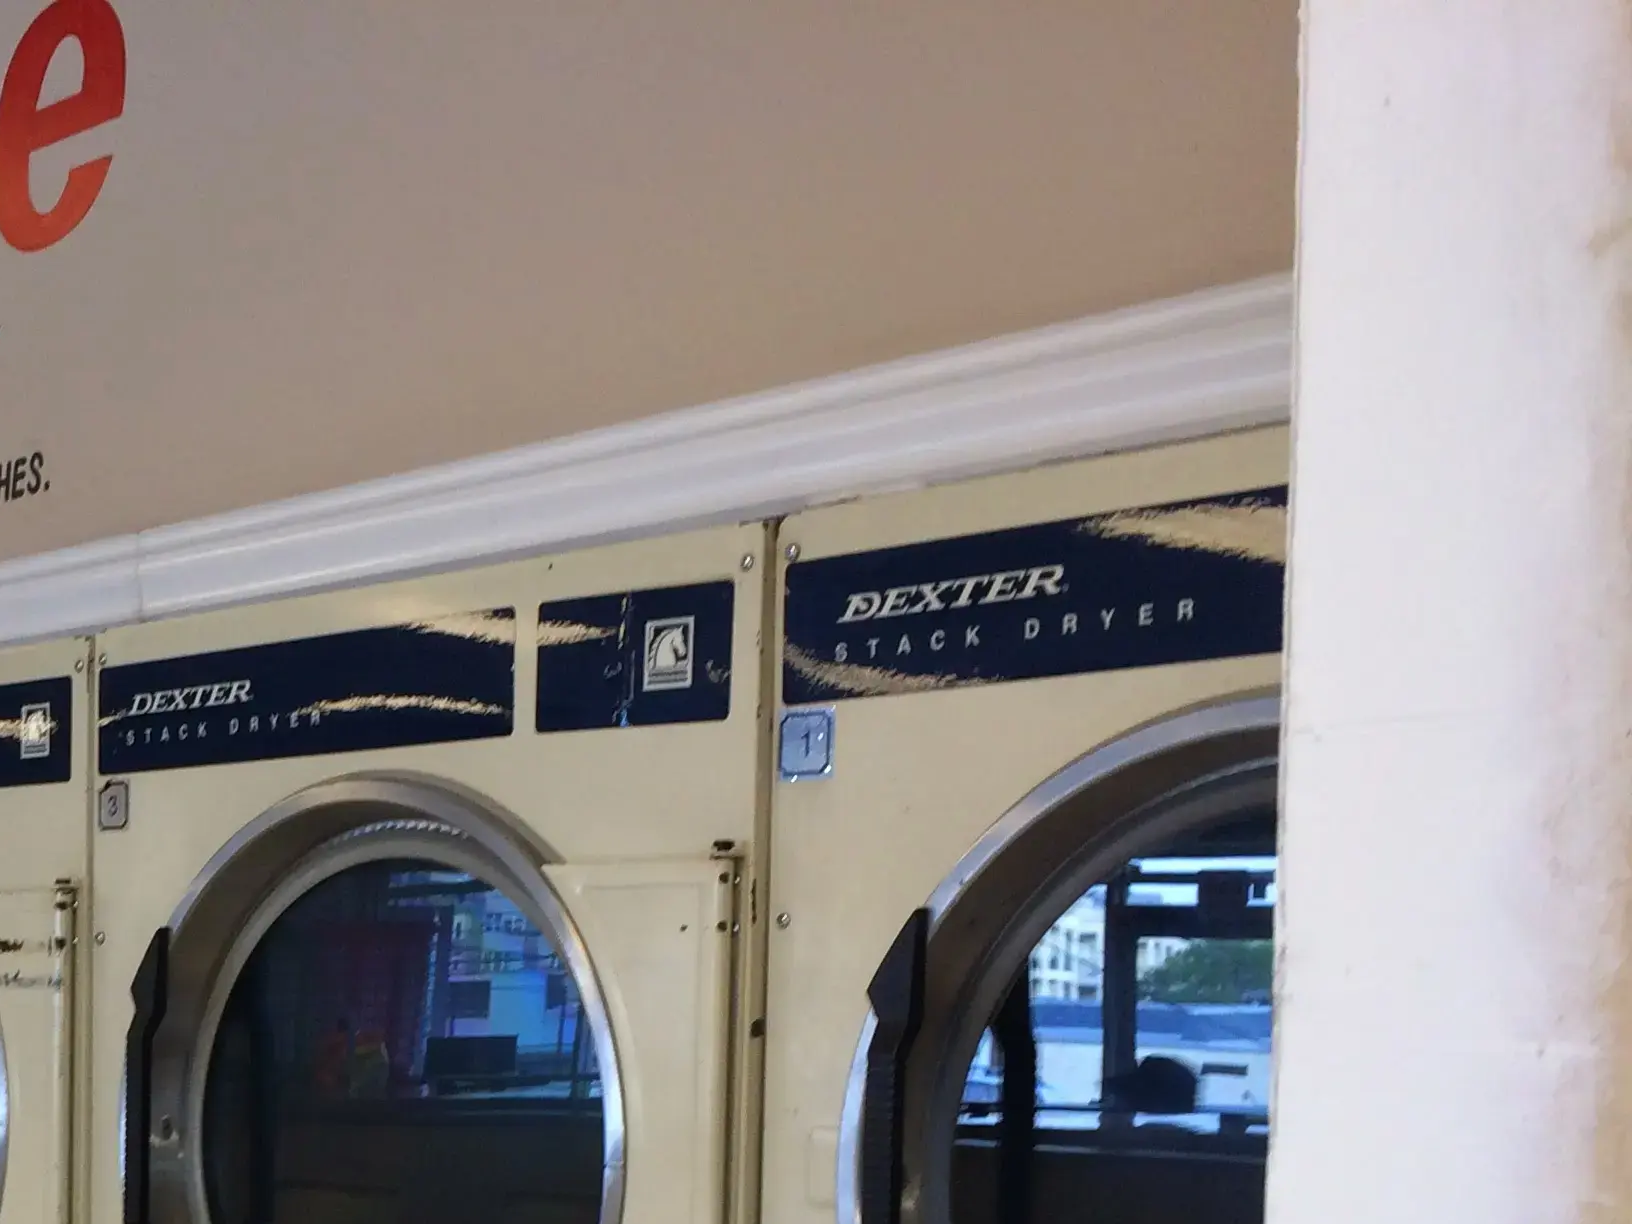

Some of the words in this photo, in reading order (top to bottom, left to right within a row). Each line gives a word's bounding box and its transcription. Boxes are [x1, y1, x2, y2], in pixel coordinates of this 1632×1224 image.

[836, 563, 1068, 624] DEXTER
[835, 626, 981, 662] STACK
[1024, 597, 1196, 641] DRYER
[128, 679, 253, 717] DEXTER
[125, 722, 208, 747] STACK
[229, 710, 321, 736] DRYER
